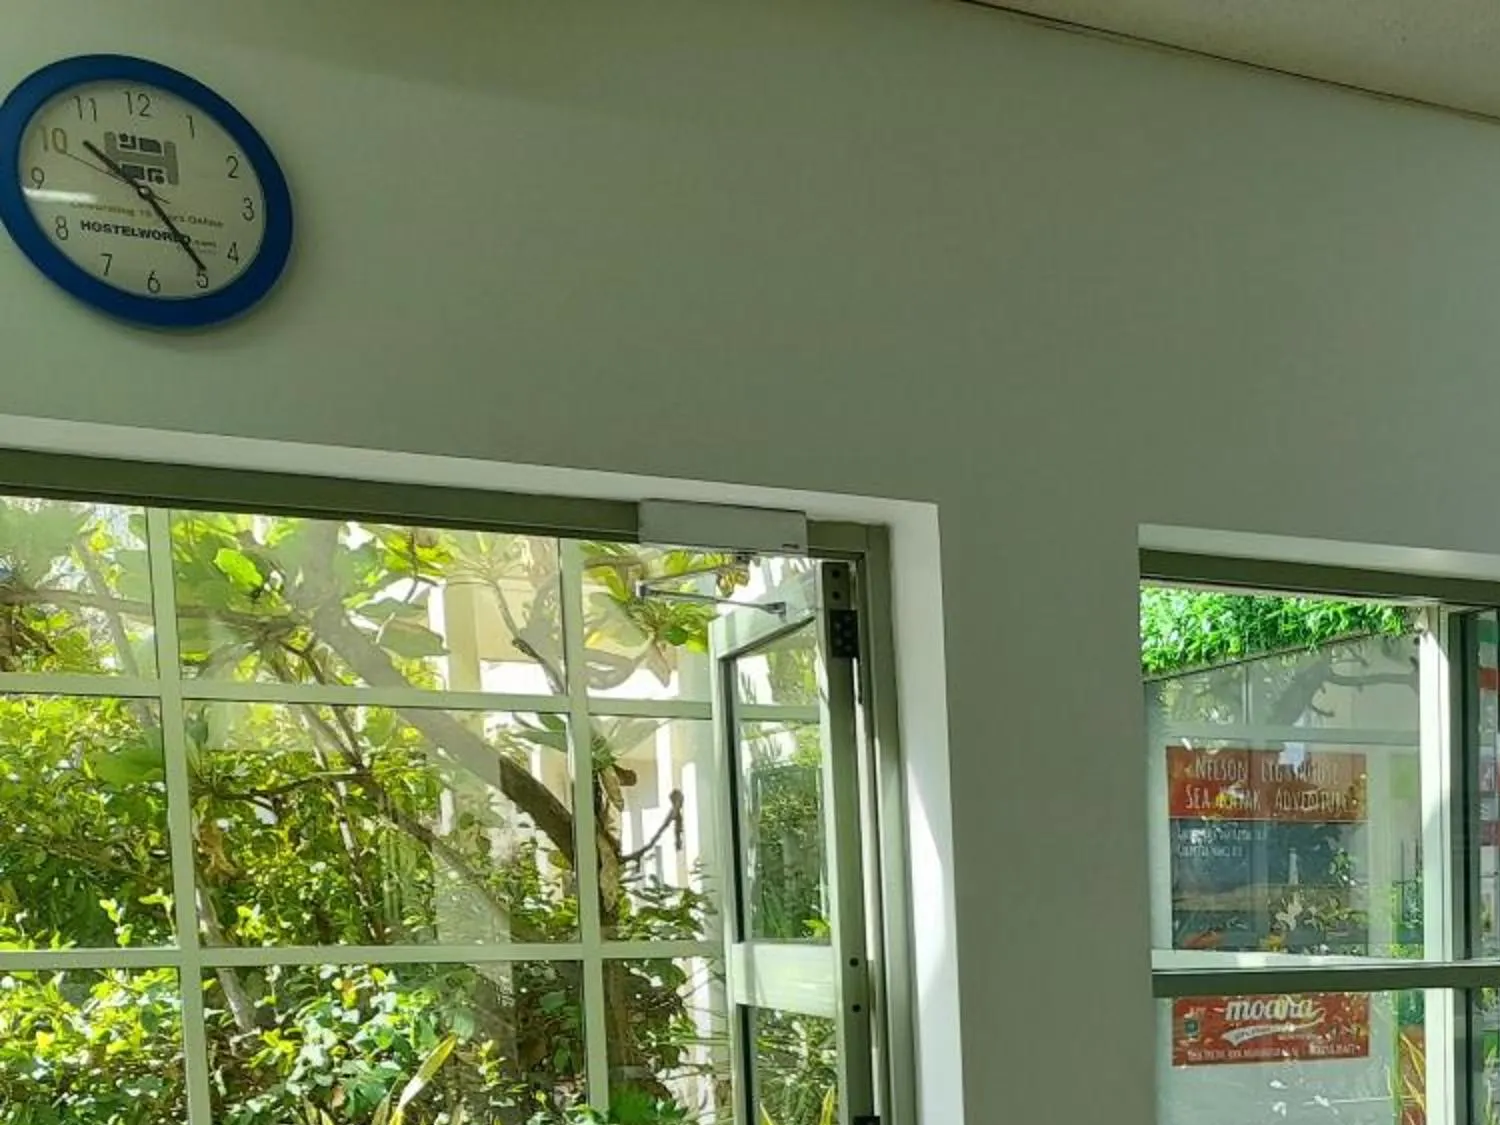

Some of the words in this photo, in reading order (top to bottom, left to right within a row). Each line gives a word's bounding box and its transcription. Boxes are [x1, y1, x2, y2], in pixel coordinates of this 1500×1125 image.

[73, 95, 98, 122] 11
[125, 91, 152, 117] 12
[186, 115, 195, 138] 1
[40, 125, 68, 154] 10
[31, 166, 45, 190] 9
[226, 155, 240, 180] 2
[242, 197, 256, 222] 3
[55, 215, 69, 240] 8
[100, 254, 113, 276] 7
[227, 242, 240, 264] 4
[147, 270, 161, 293] 6
